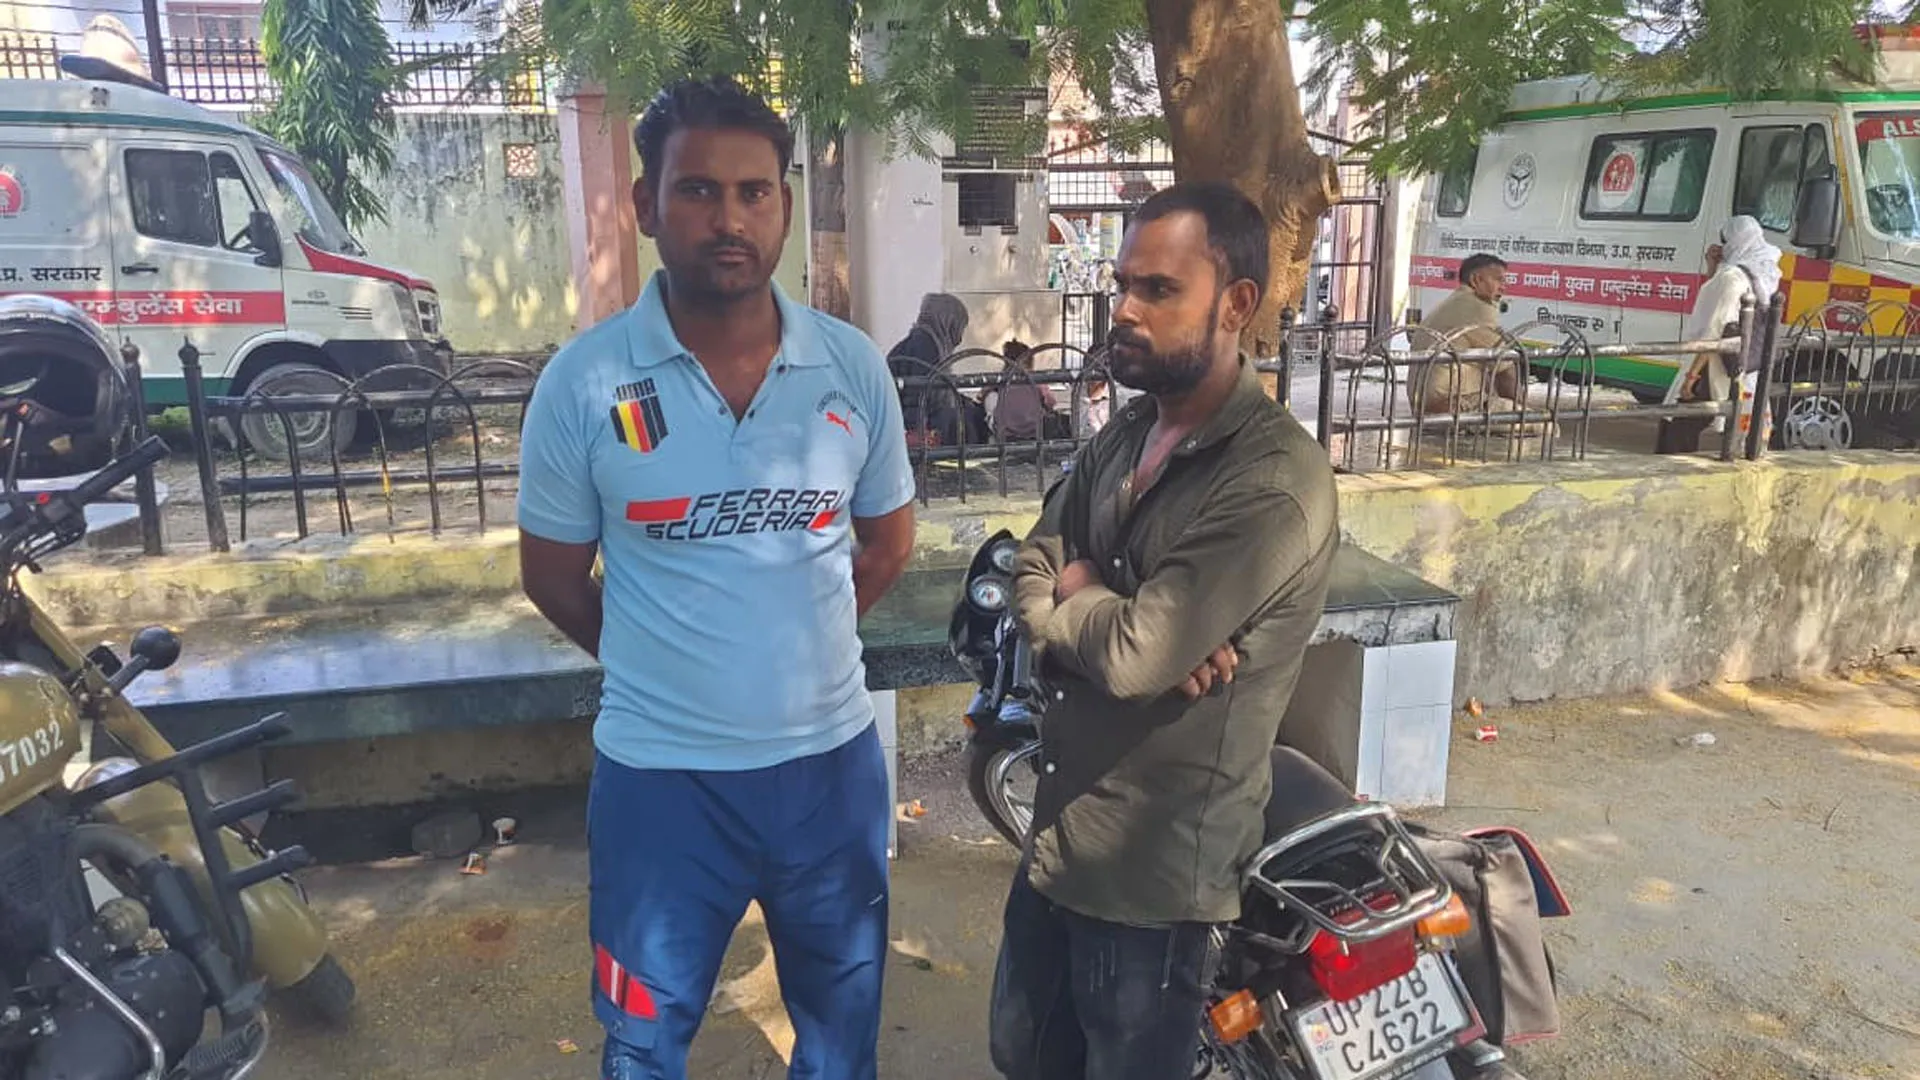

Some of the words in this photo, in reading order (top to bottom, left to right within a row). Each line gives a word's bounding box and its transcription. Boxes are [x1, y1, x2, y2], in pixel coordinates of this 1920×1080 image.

[1636, 245, 1677, 261] सरकार
[30, 267, 102, 282] सरकार
[1565, 276, 1595, 298] युक्त
[1657, 276, 1690, 300] सेवा
[191, 293, 243, 315] सेवा
[691, 489, 845, 517] FERRARI
[645, 511, 817, 541] SCUDERIA
[1322, 967, 1429, 1036] UP22B
[1341, 1001, 1447, 1074] C4622
